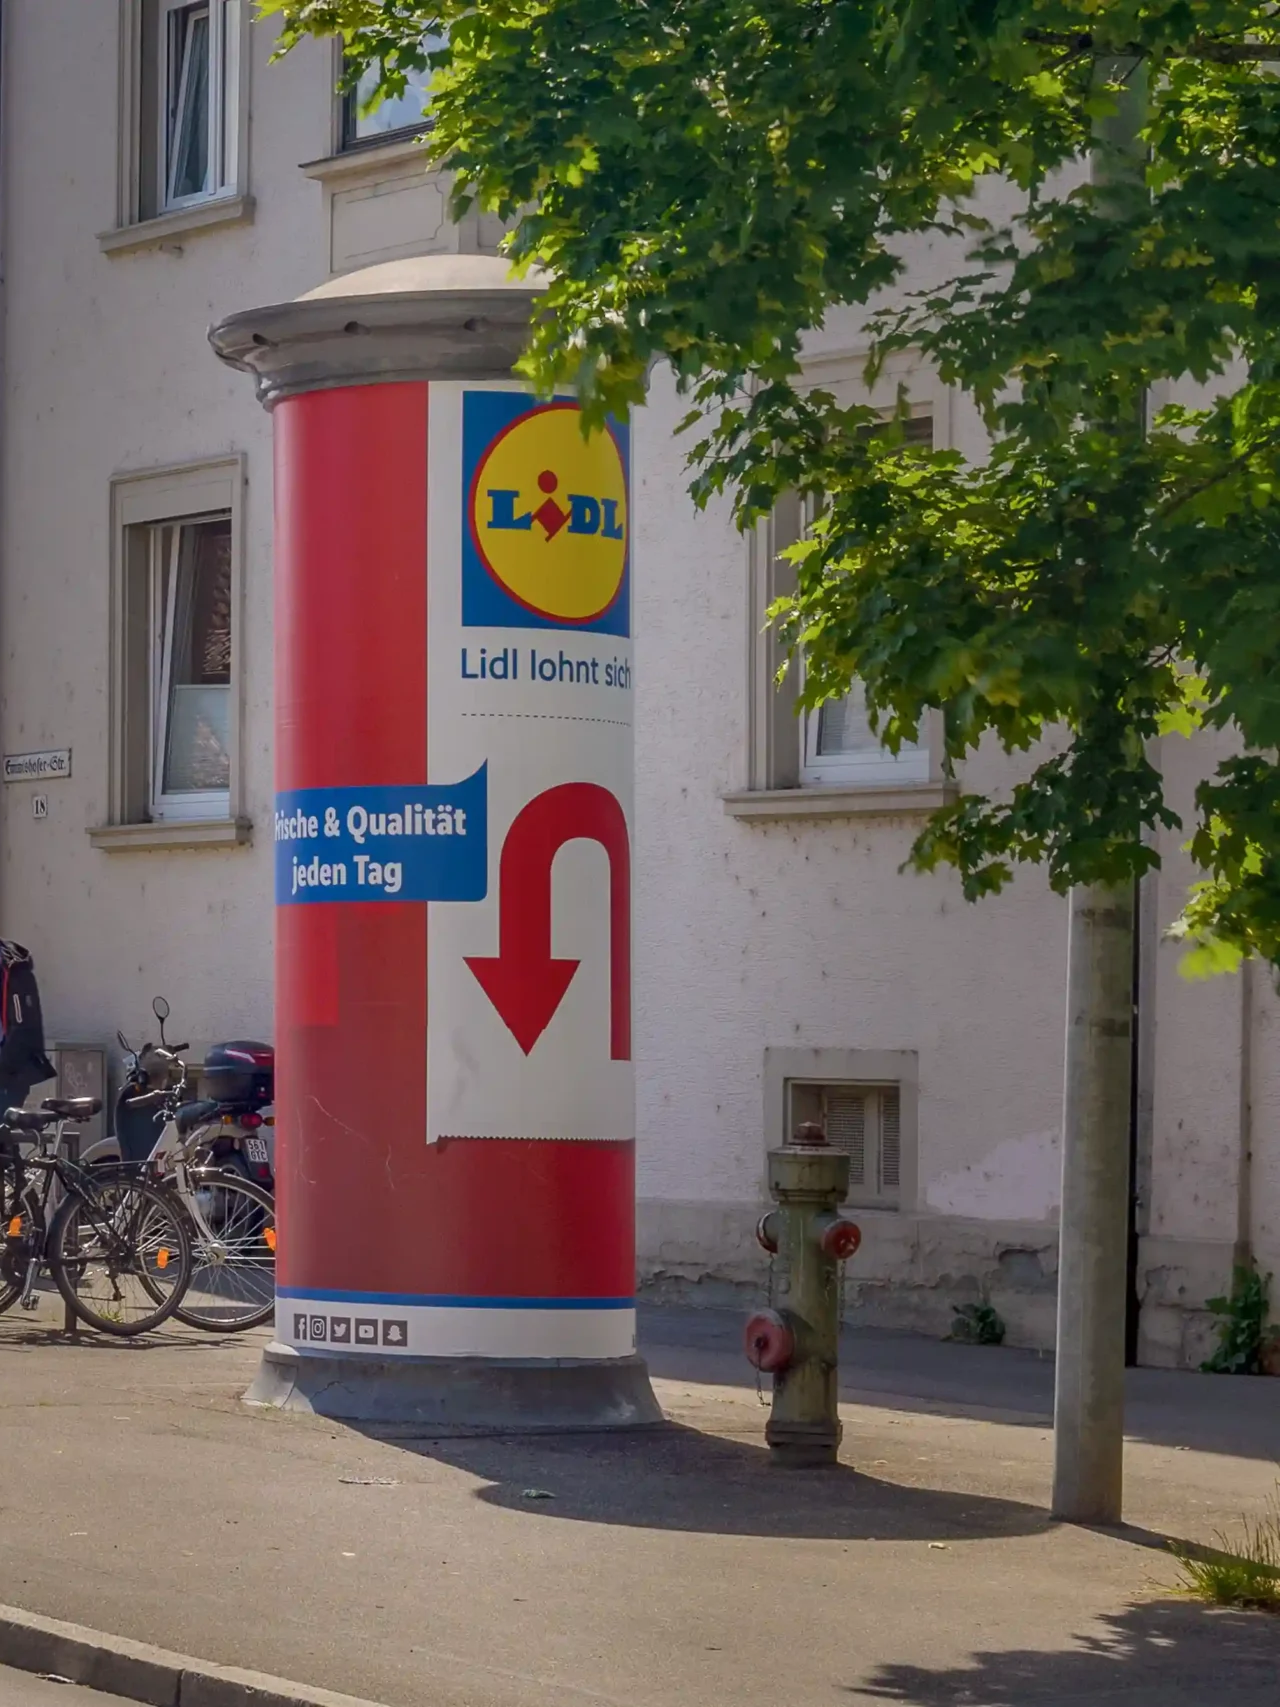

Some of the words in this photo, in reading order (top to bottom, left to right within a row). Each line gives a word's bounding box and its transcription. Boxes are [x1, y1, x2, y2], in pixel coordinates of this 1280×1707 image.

[461, 648, 518, 680] Lidl
[531, 649, 599, 685] lohnt
[605, 656, 632, 690] sich
[35, 799, 46, 814] 18
[323, 806, 340, 837] &
[346, 803, 467, 844] Qualität
[291, 856, 347, 895] jeden
[353, 854, 402, 893] Tag
[248, 1140, 264, 1151] 561
